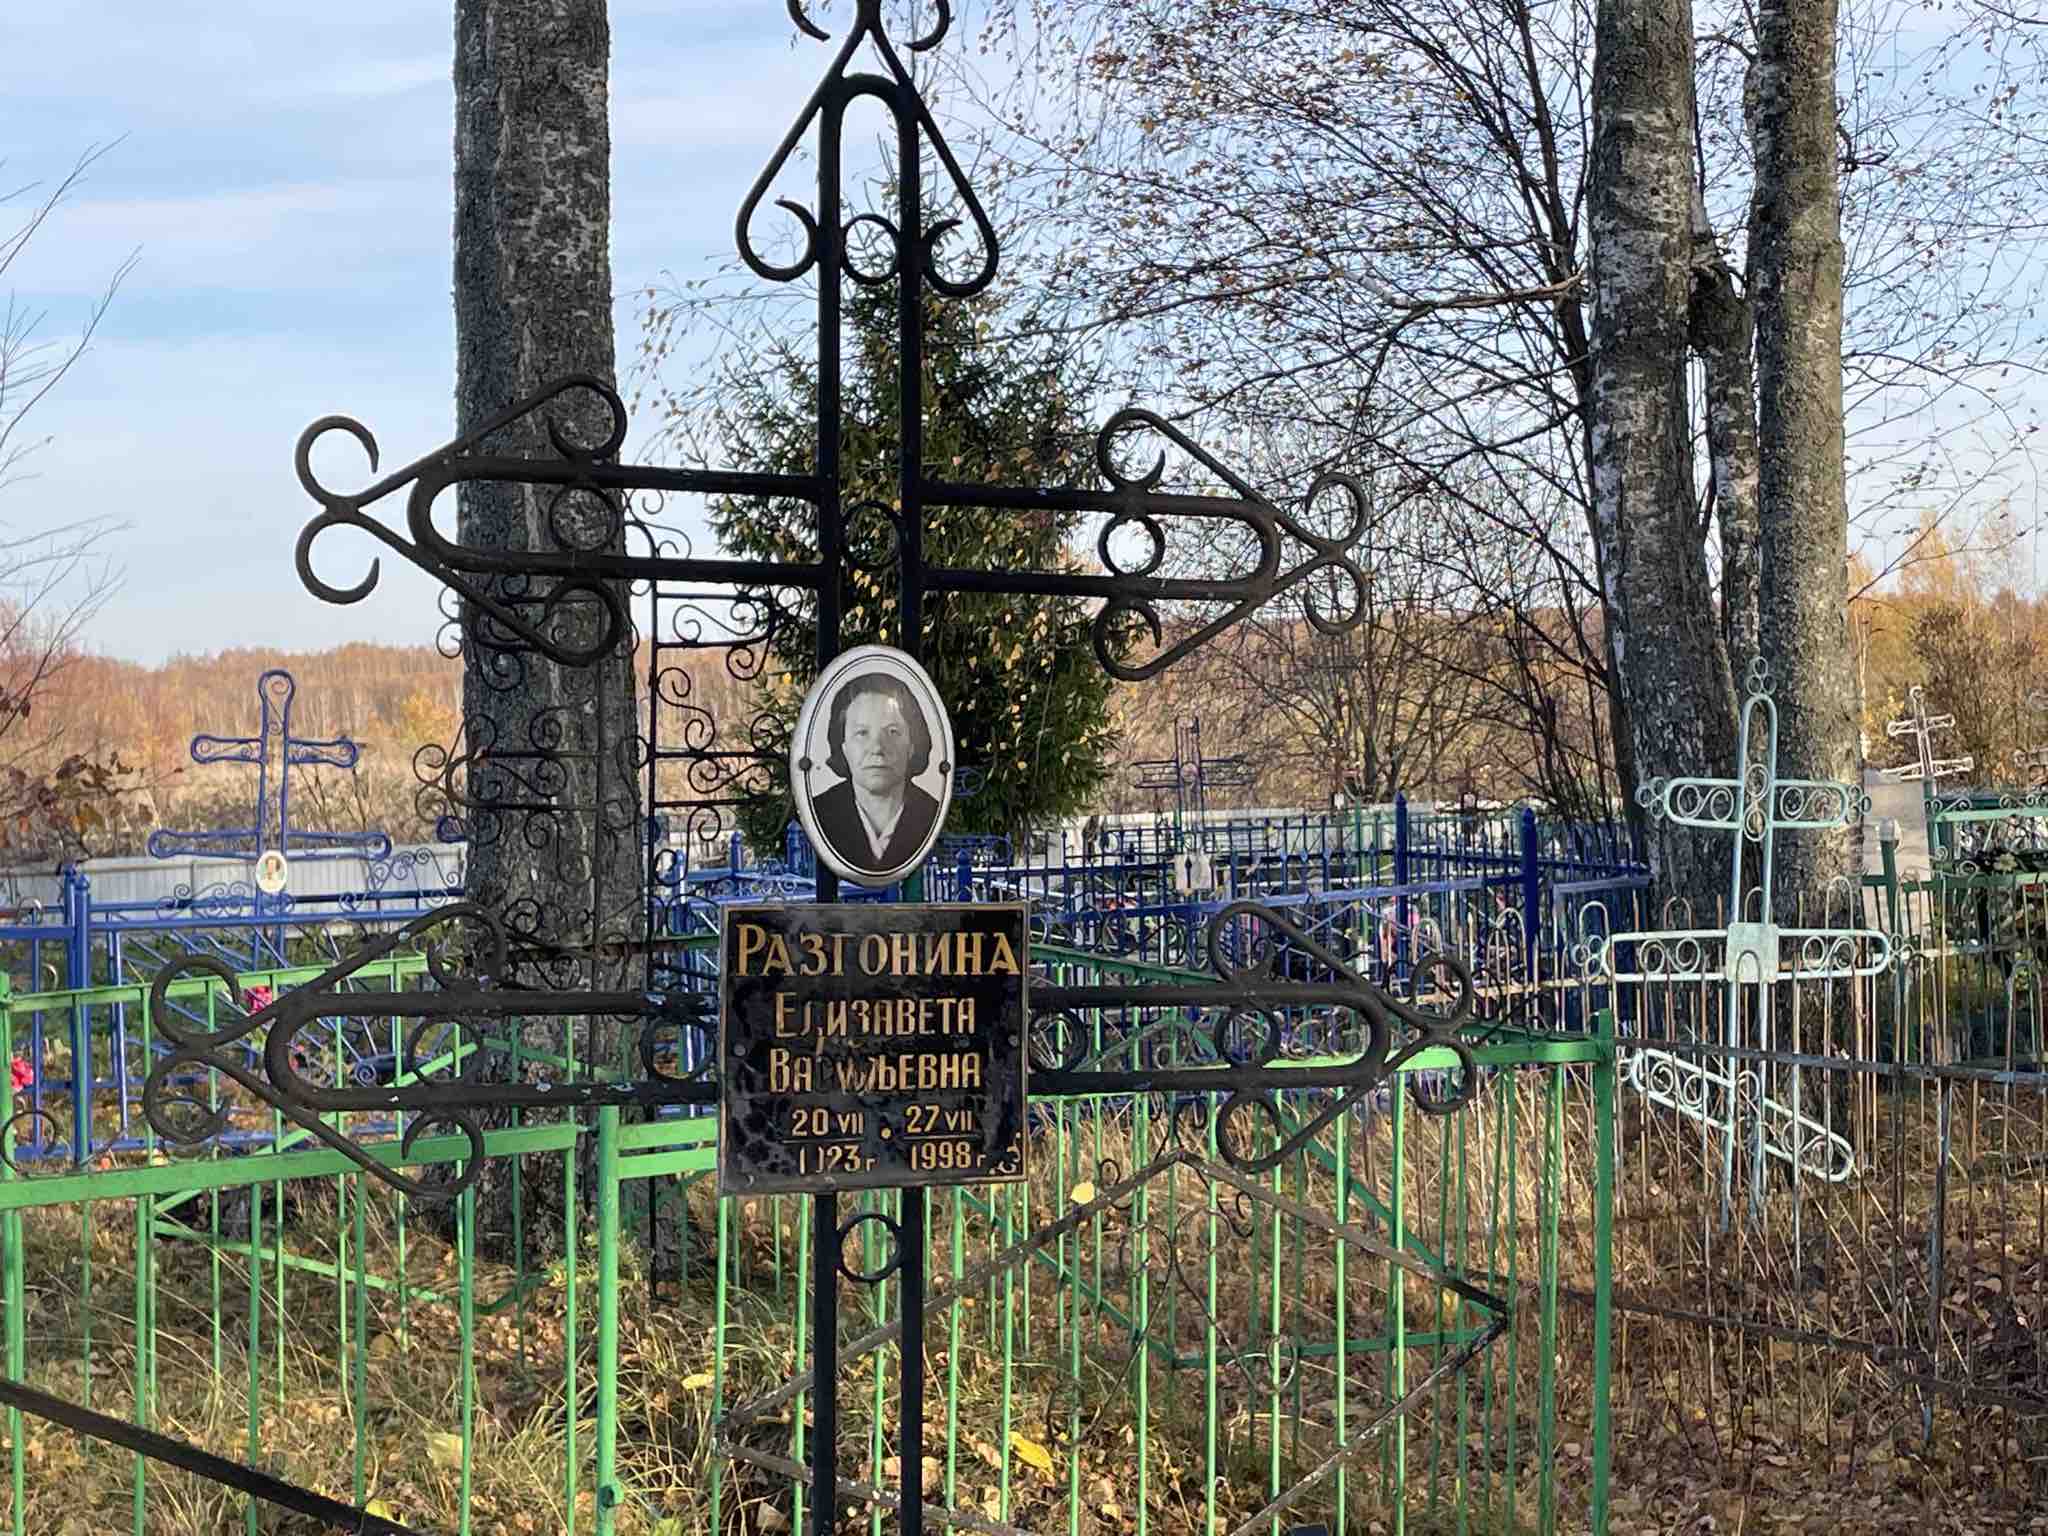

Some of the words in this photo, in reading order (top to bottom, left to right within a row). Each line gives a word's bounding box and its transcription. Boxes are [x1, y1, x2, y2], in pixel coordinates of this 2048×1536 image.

[735, 923, 1020, 976] РАЗГОНИНА
[768, 1047, 982, 1093] ВАИЛЬЕВНА
[791, 1108, 829, 1137] 20
[905, 1104, 940, 1133] 27
